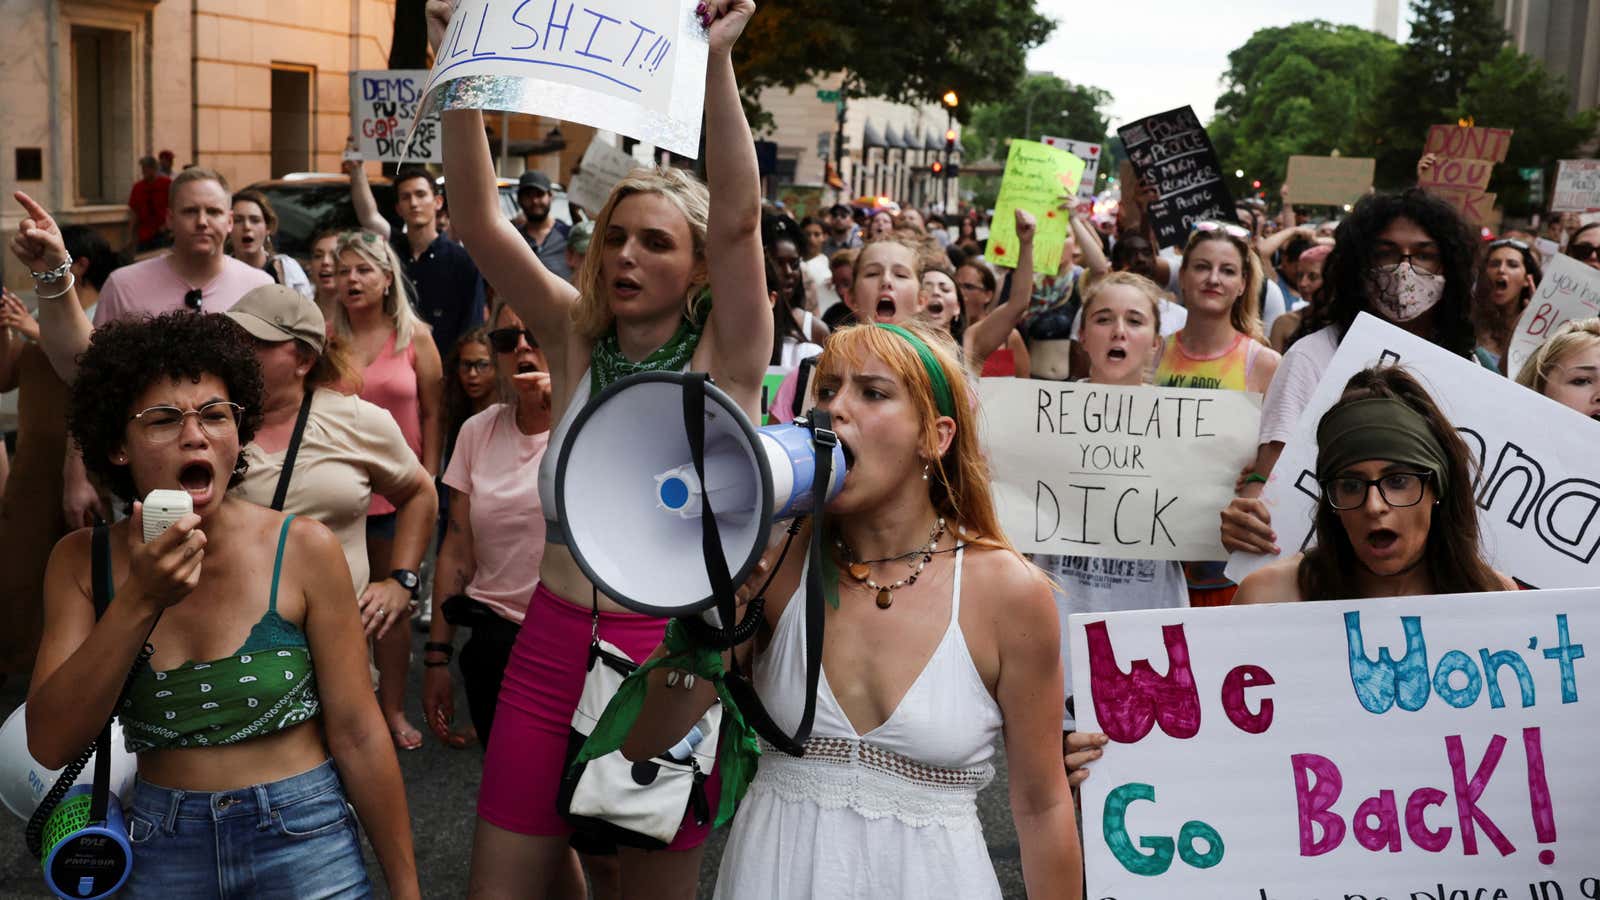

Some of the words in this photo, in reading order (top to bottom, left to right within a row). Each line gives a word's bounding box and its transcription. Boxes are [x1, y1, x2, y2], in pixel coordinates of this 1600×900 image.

[362, 77, 416, 103] DEMS
[362, 115, 399, 139] GOP
[376, 138, 432, 159] DICKS
[1150, 165, 1217, 200] TRONGER
[1432, 160, 1488, 184] YOU
[1036, 388, 1216, 439] REGULATE
[1080, 443, 1145, 470] YOUR
[1035, 480, 1179, 547] DICK
[1062, 555, 1090, 571] HOT
[1084, 620, 1275, 744] We
[1343, 610, 1585, 714] Won't
[1102, 782, 1225, 876] Go
[1290, 726, 1557, 865] Back!
